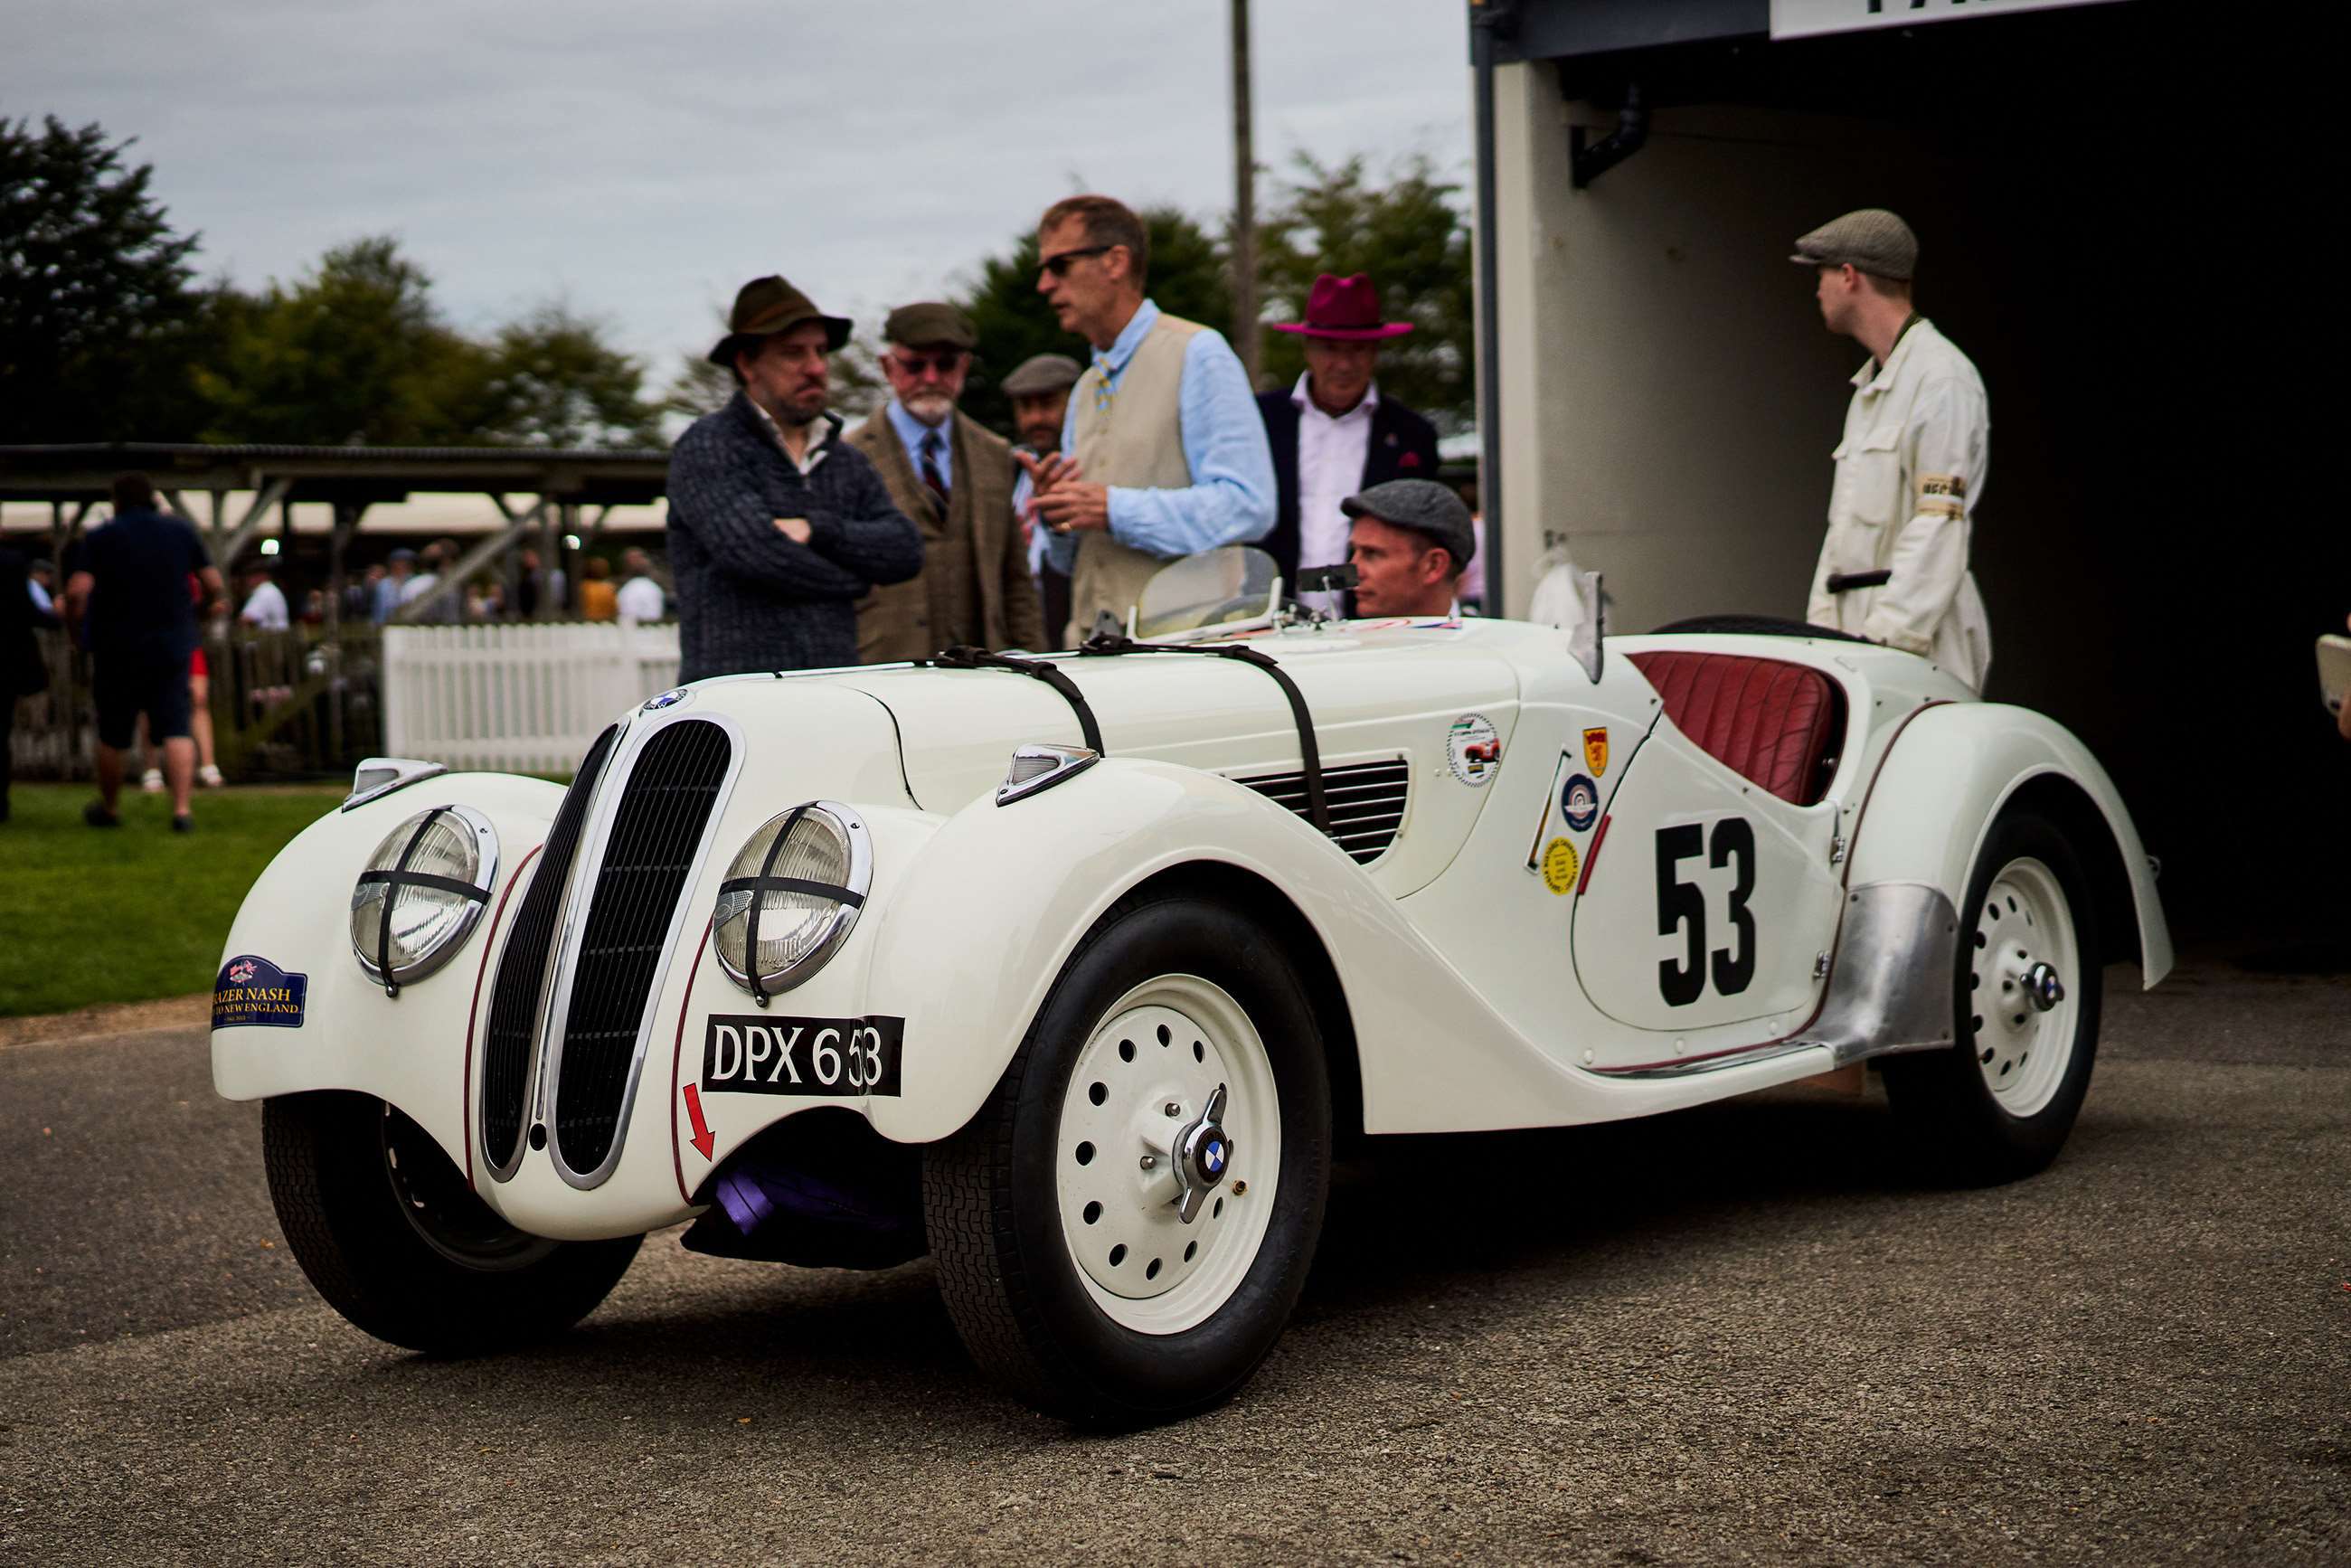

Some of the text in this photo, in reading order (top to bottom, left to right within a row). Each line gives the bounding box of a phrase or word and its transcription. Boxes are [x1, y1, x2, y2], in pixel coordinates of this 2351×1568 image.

[1656, 817, 1756, 1007] 53
[224, 1003, 244, 1014] NEW
[245, 1003, 298, 1014] ENGLAND
[246, 987, 290, 1002] NASH
[711, 1025, 883, 1087] DPX 653
